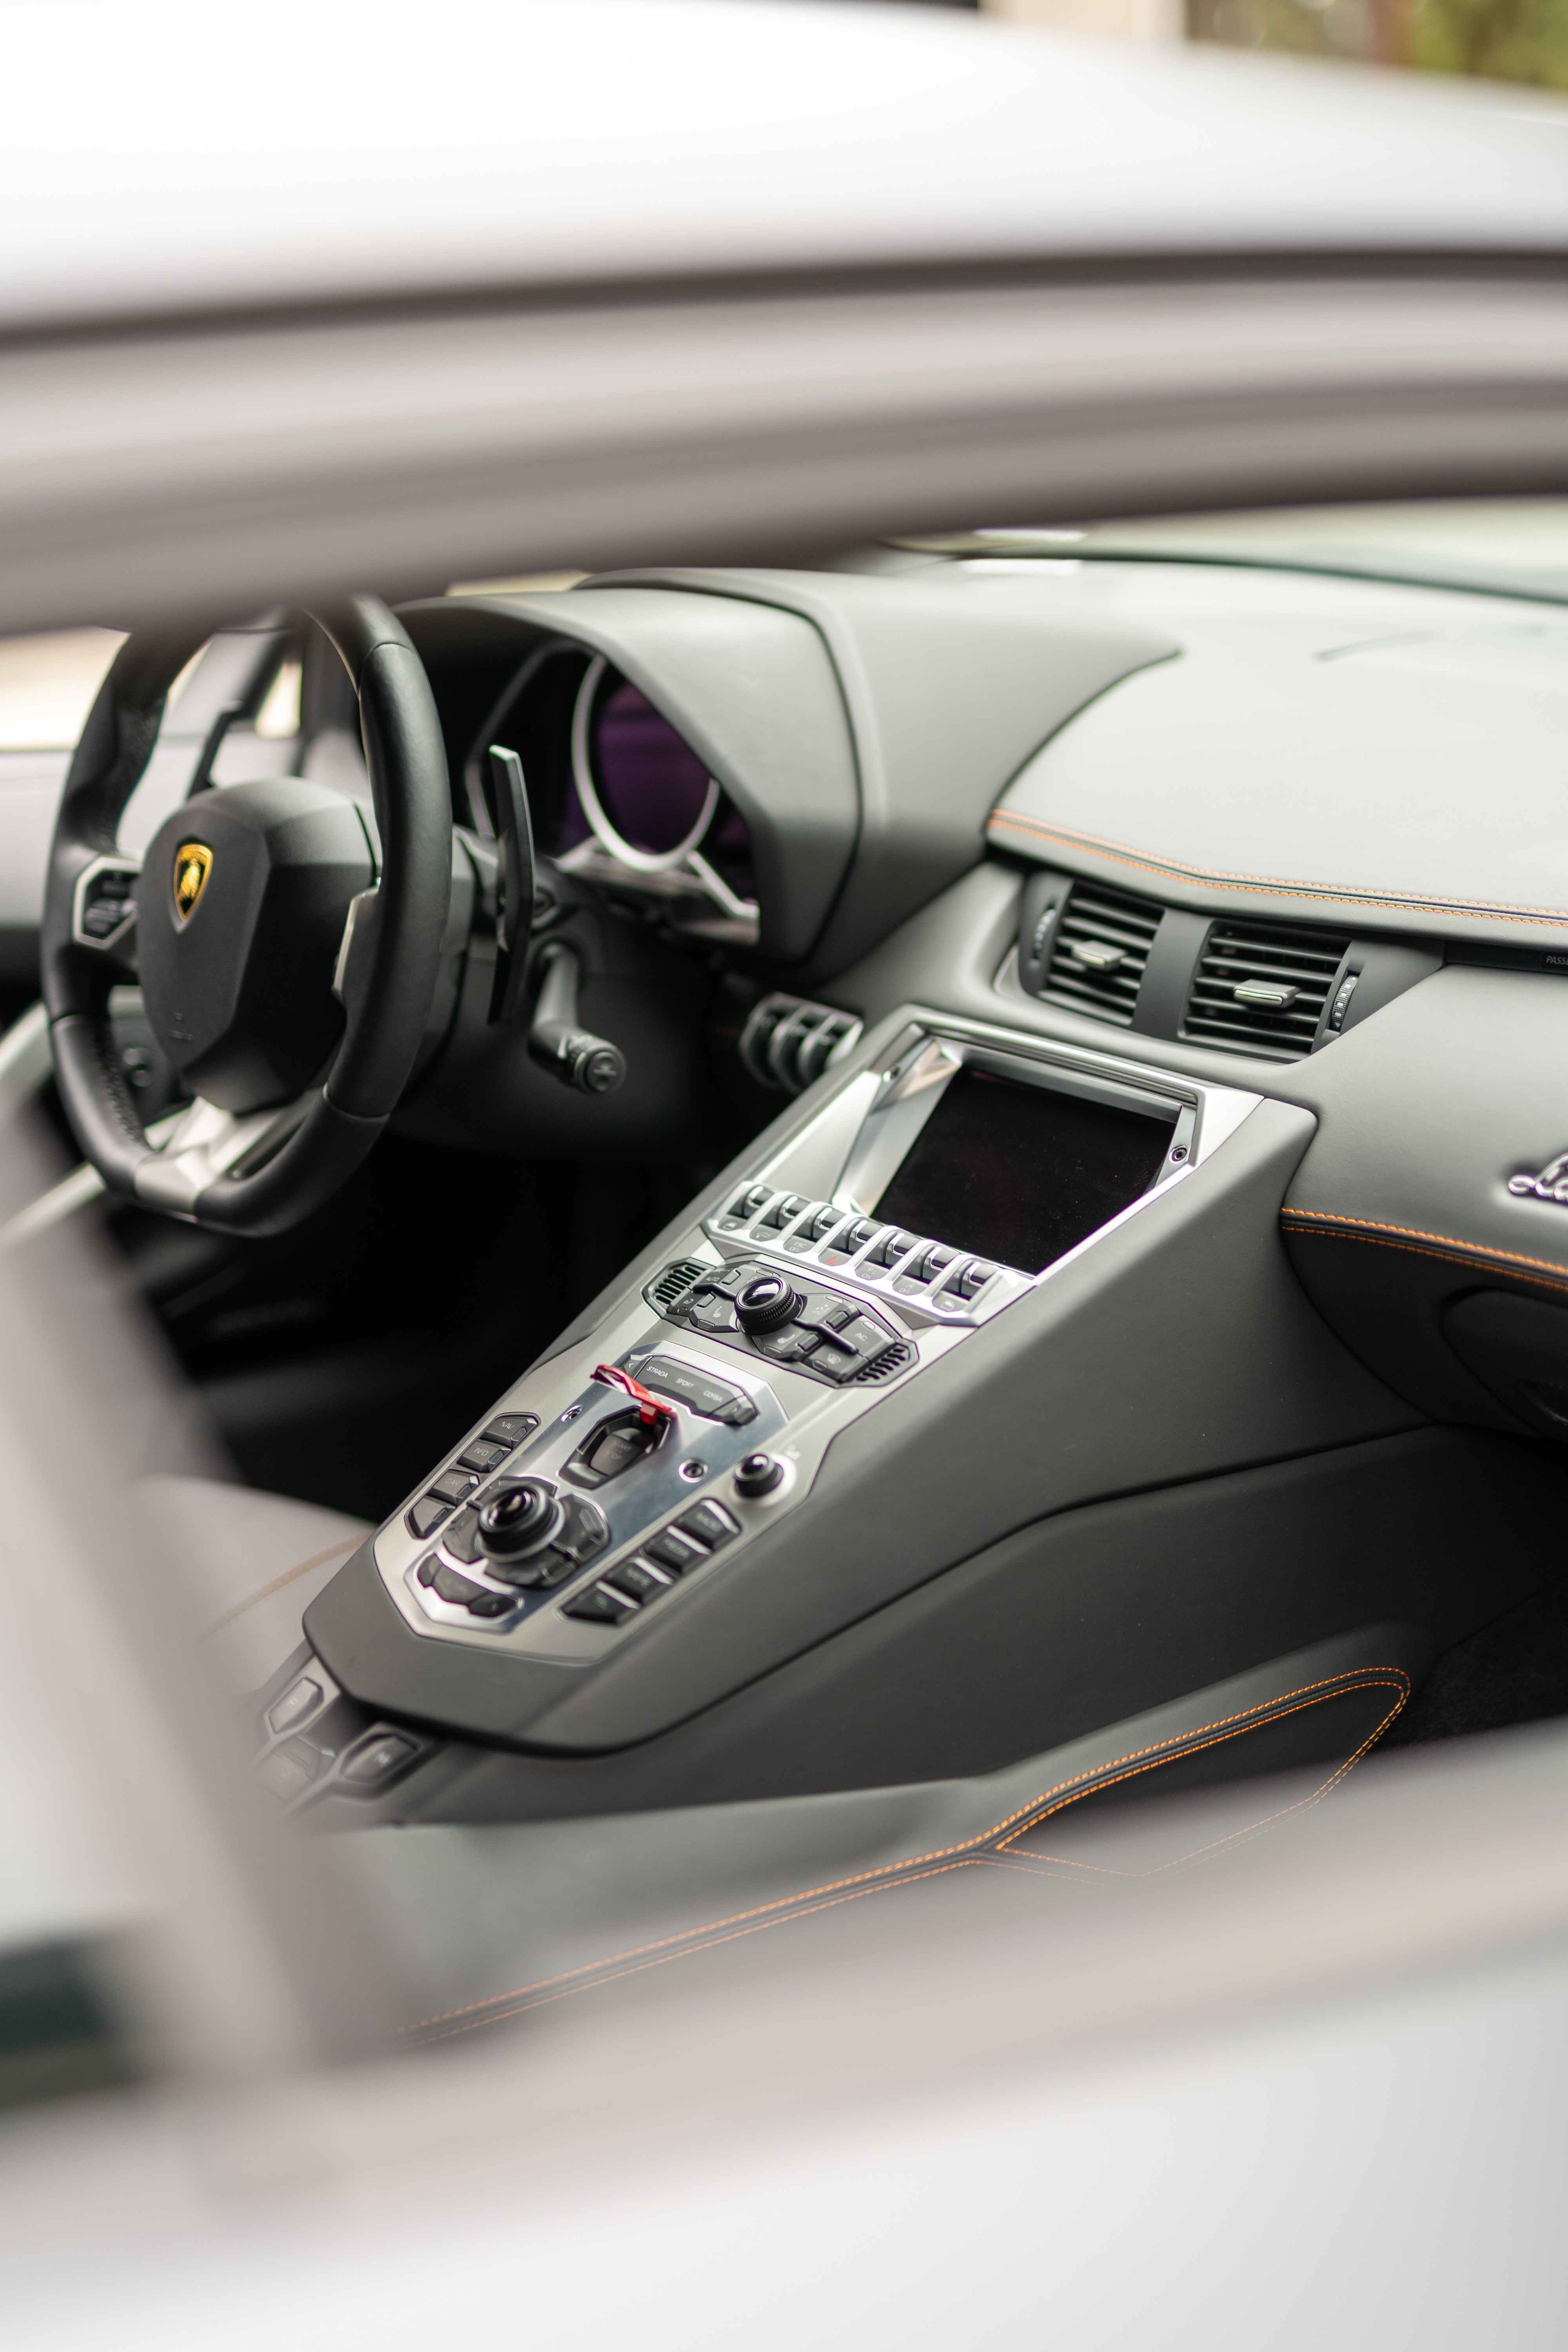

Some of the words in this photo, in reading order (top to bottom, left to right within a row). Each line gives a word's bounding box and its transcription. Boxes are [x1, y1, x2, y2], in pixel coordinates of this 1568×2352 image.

[855, 1332, 867, 1341] AC
[646, 1366, 668, 1378] STRADA
[676, 1378, 695, 1388] SPORT
[499, 1421, 515, 1429] NAV
[474, 1447, 489, 1456] INFO
[445, 1478, 460, 1486] CAR
